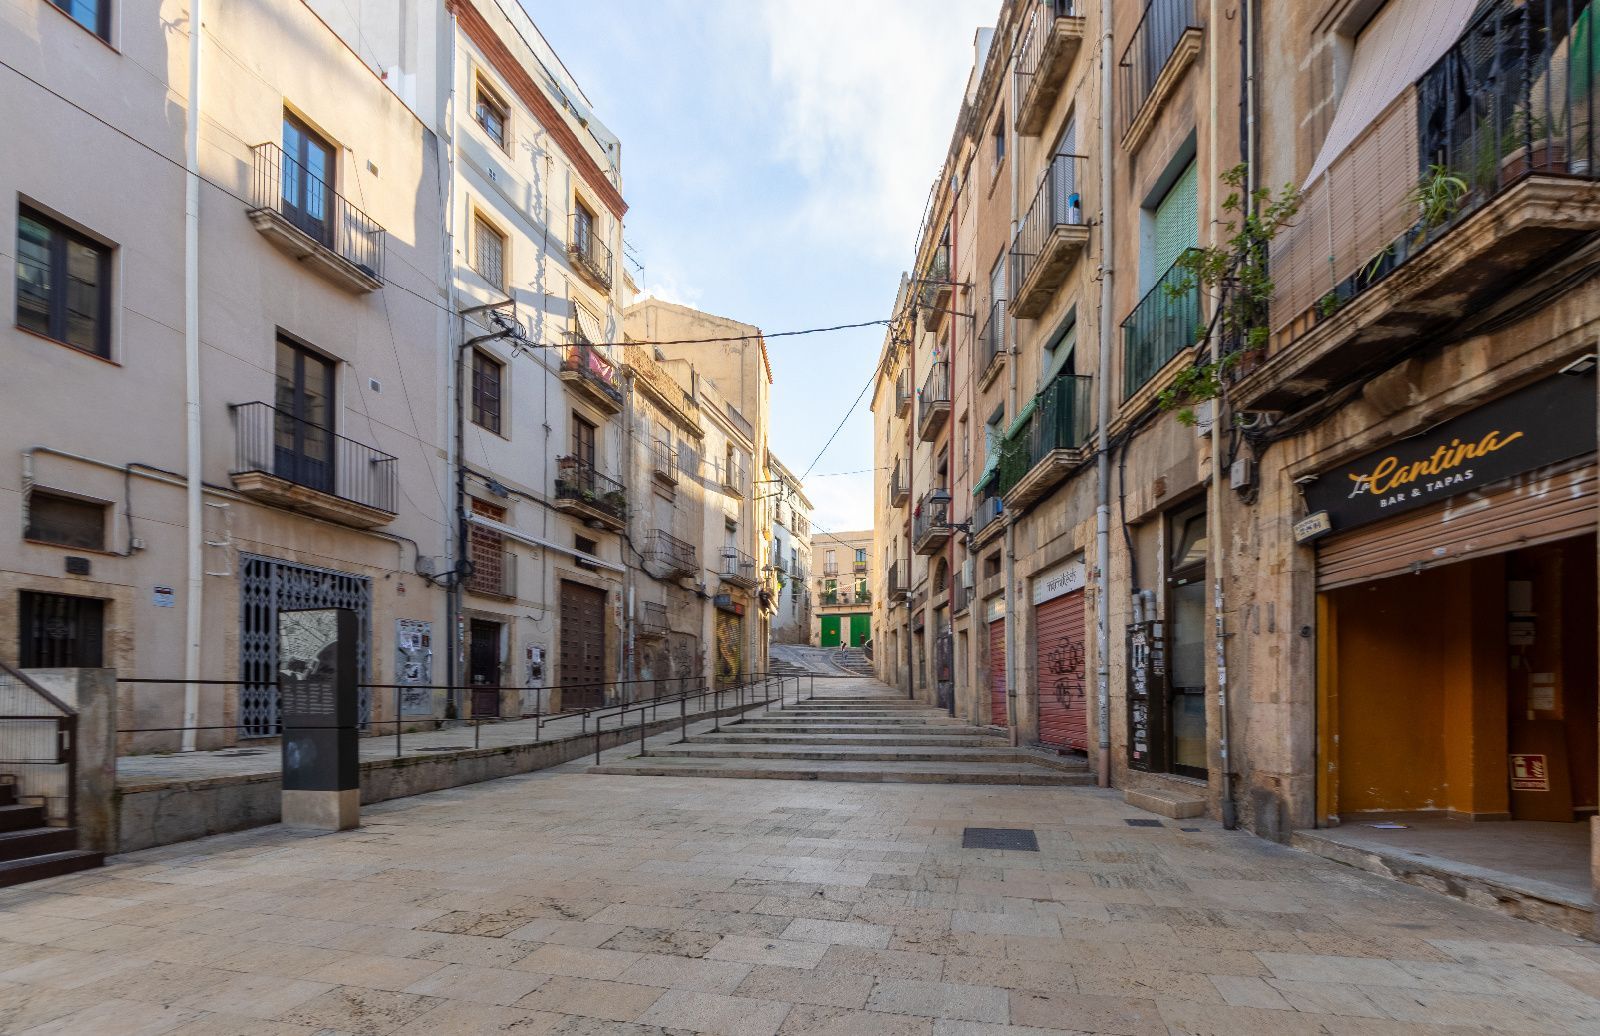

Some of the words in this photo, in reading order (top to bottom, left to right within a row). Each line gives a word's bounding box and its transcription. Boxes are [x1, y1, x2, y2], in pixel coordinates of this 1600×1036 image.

[1349, 430, 1524, 494] Cantina
[1348, 474, 1371, 499] La
[1380, 493, 1406, 508] BAR
[1411, 488, 1422, 498] &
[1426, 469, 1474, 492] TAPAS
